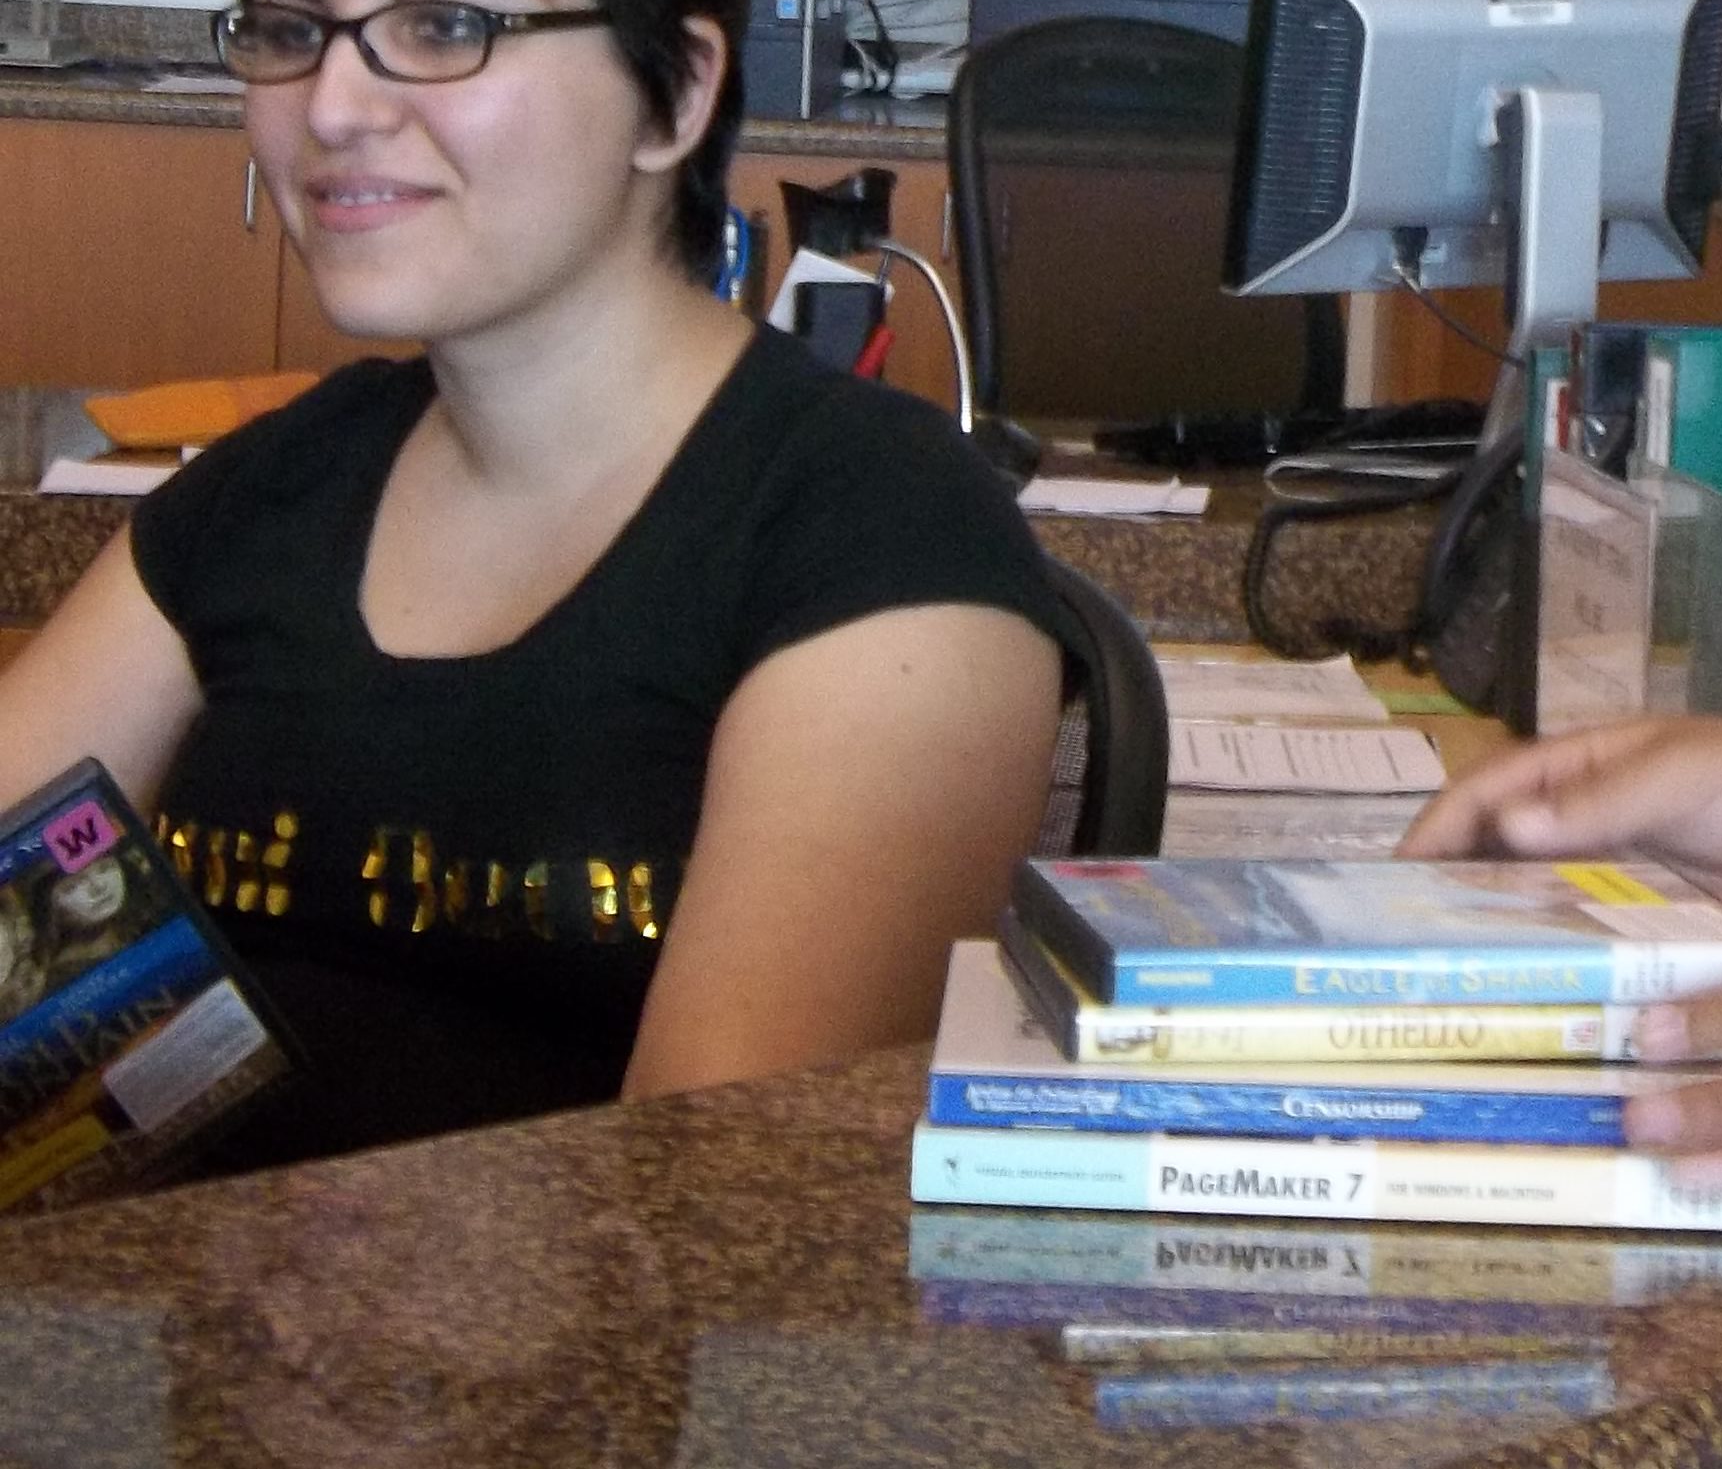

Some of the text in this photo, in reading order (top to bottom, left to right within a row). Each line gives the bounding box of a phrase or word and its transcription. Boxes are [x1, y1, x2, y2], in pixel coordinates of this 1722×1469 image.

[55, 817, 98, 860] W
[1295, 964, 1413, 995] EAGLE
[1328, 1009, 1483, 1050] OTHELLO
[1348, 1172, 1364, 1201] 7
